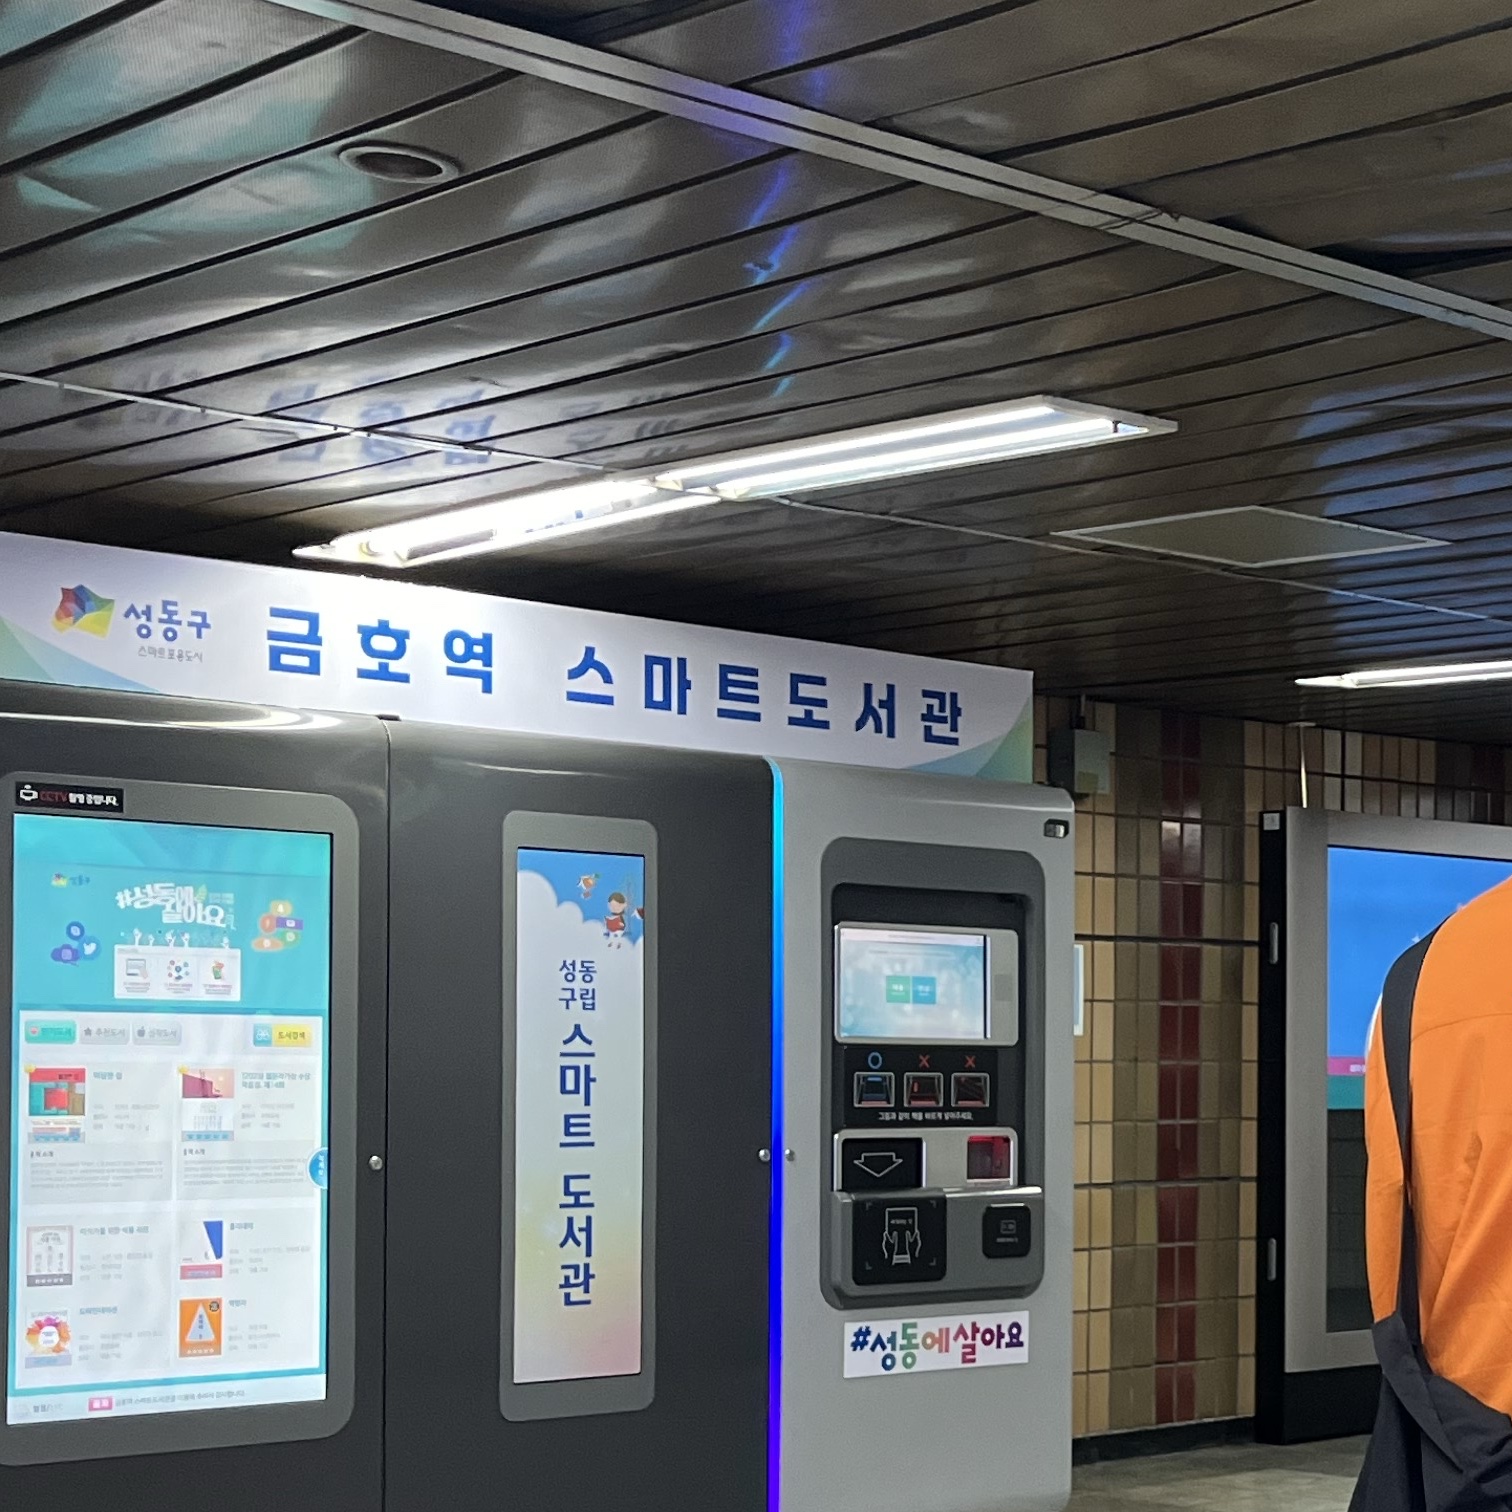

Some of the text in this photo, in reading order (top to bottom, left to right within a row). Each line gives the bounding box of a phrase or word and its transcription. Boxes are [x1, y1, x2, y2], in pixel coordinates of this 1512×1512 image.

[124, 600, 212, 642] 성동구
[266, 606, 963, 747] 금호역 스마트도서관
[559, 959, 597, 984] 성동
[558, 987, 596, 1011] 구립
[557, 1023, 597, 1307] 스마트 도서관
